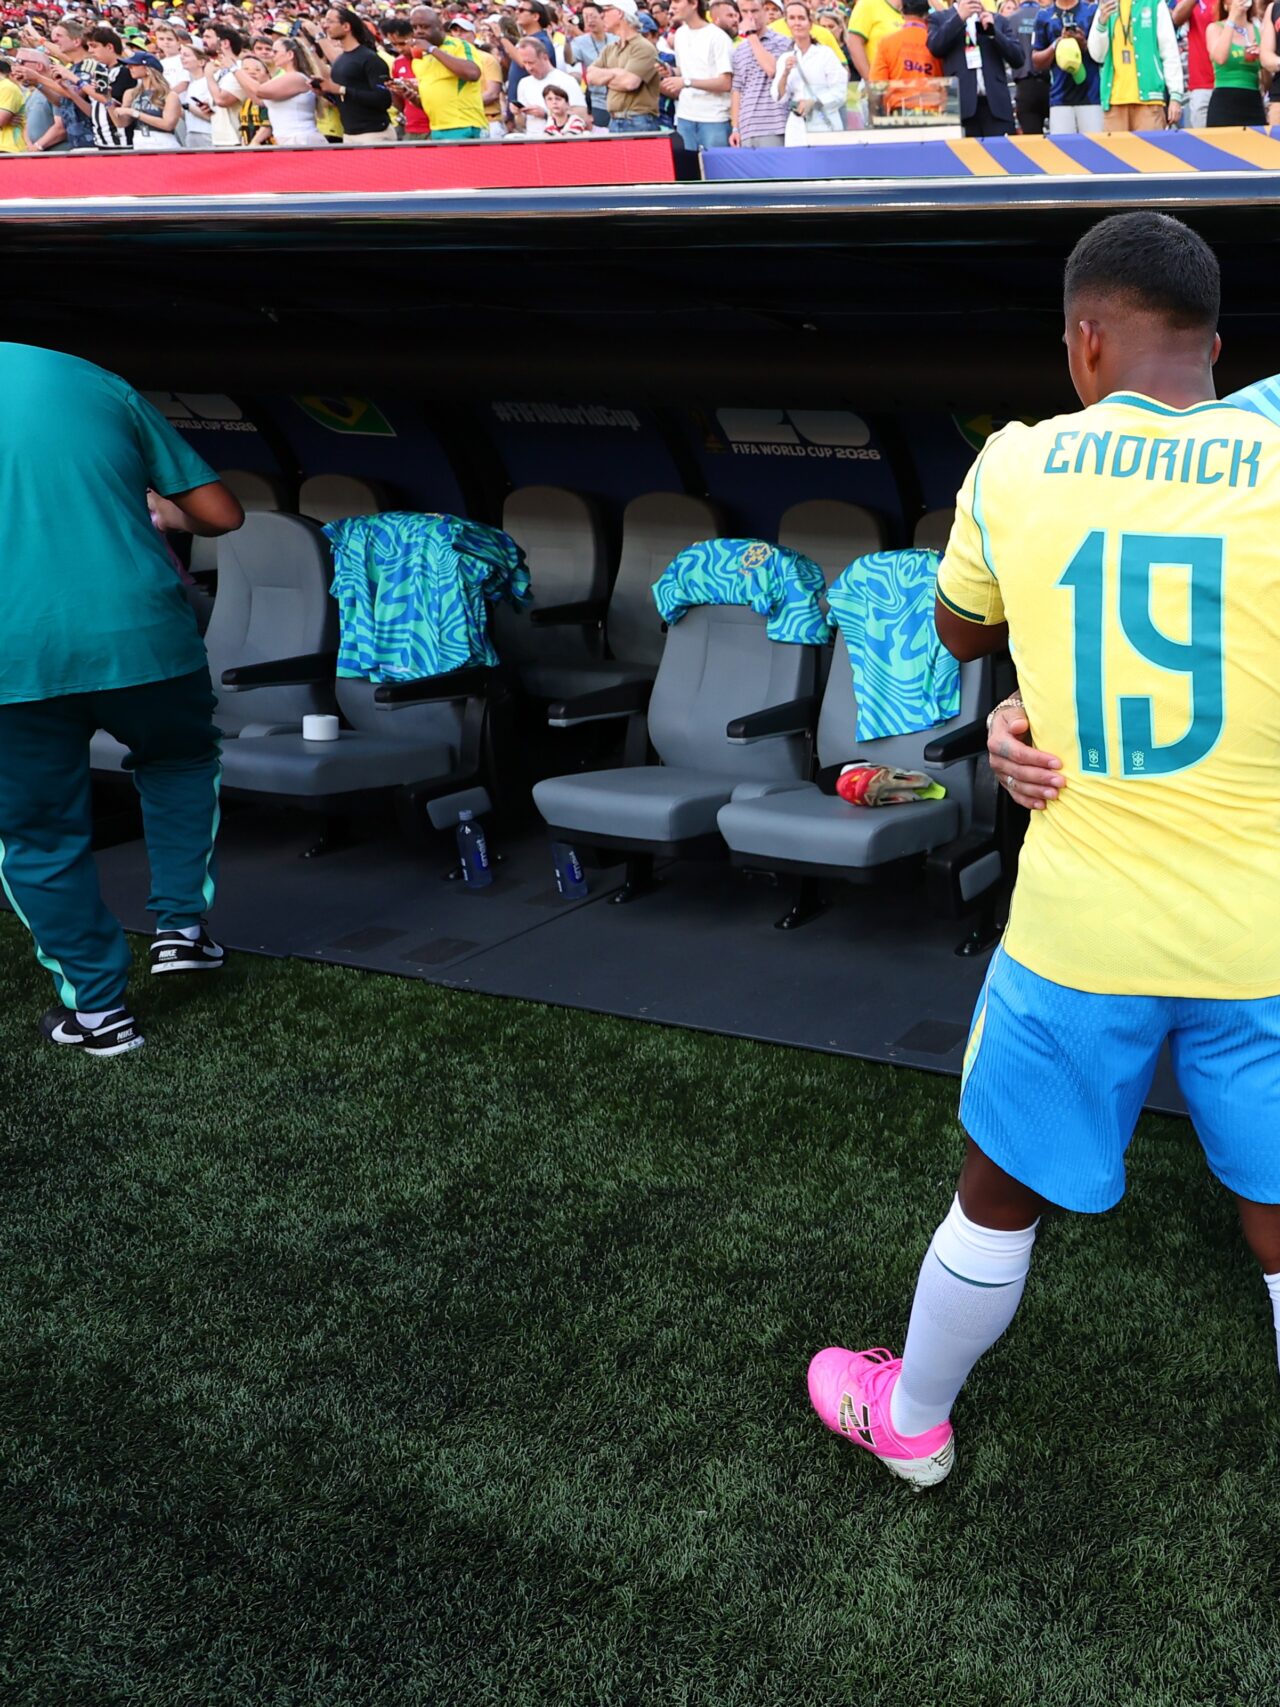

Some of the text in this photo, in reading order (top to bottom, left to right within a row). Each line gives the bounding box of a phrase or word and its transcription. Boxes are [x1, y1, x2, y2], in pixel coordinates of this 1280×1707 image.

[904, 59, 933, 75] 942
[731, 443, 881, 460] FIFA WORLD CUP 2026
[1044, 431, 1262, 487] ENDRICK
[1054, 529, 1226, 779] 19
